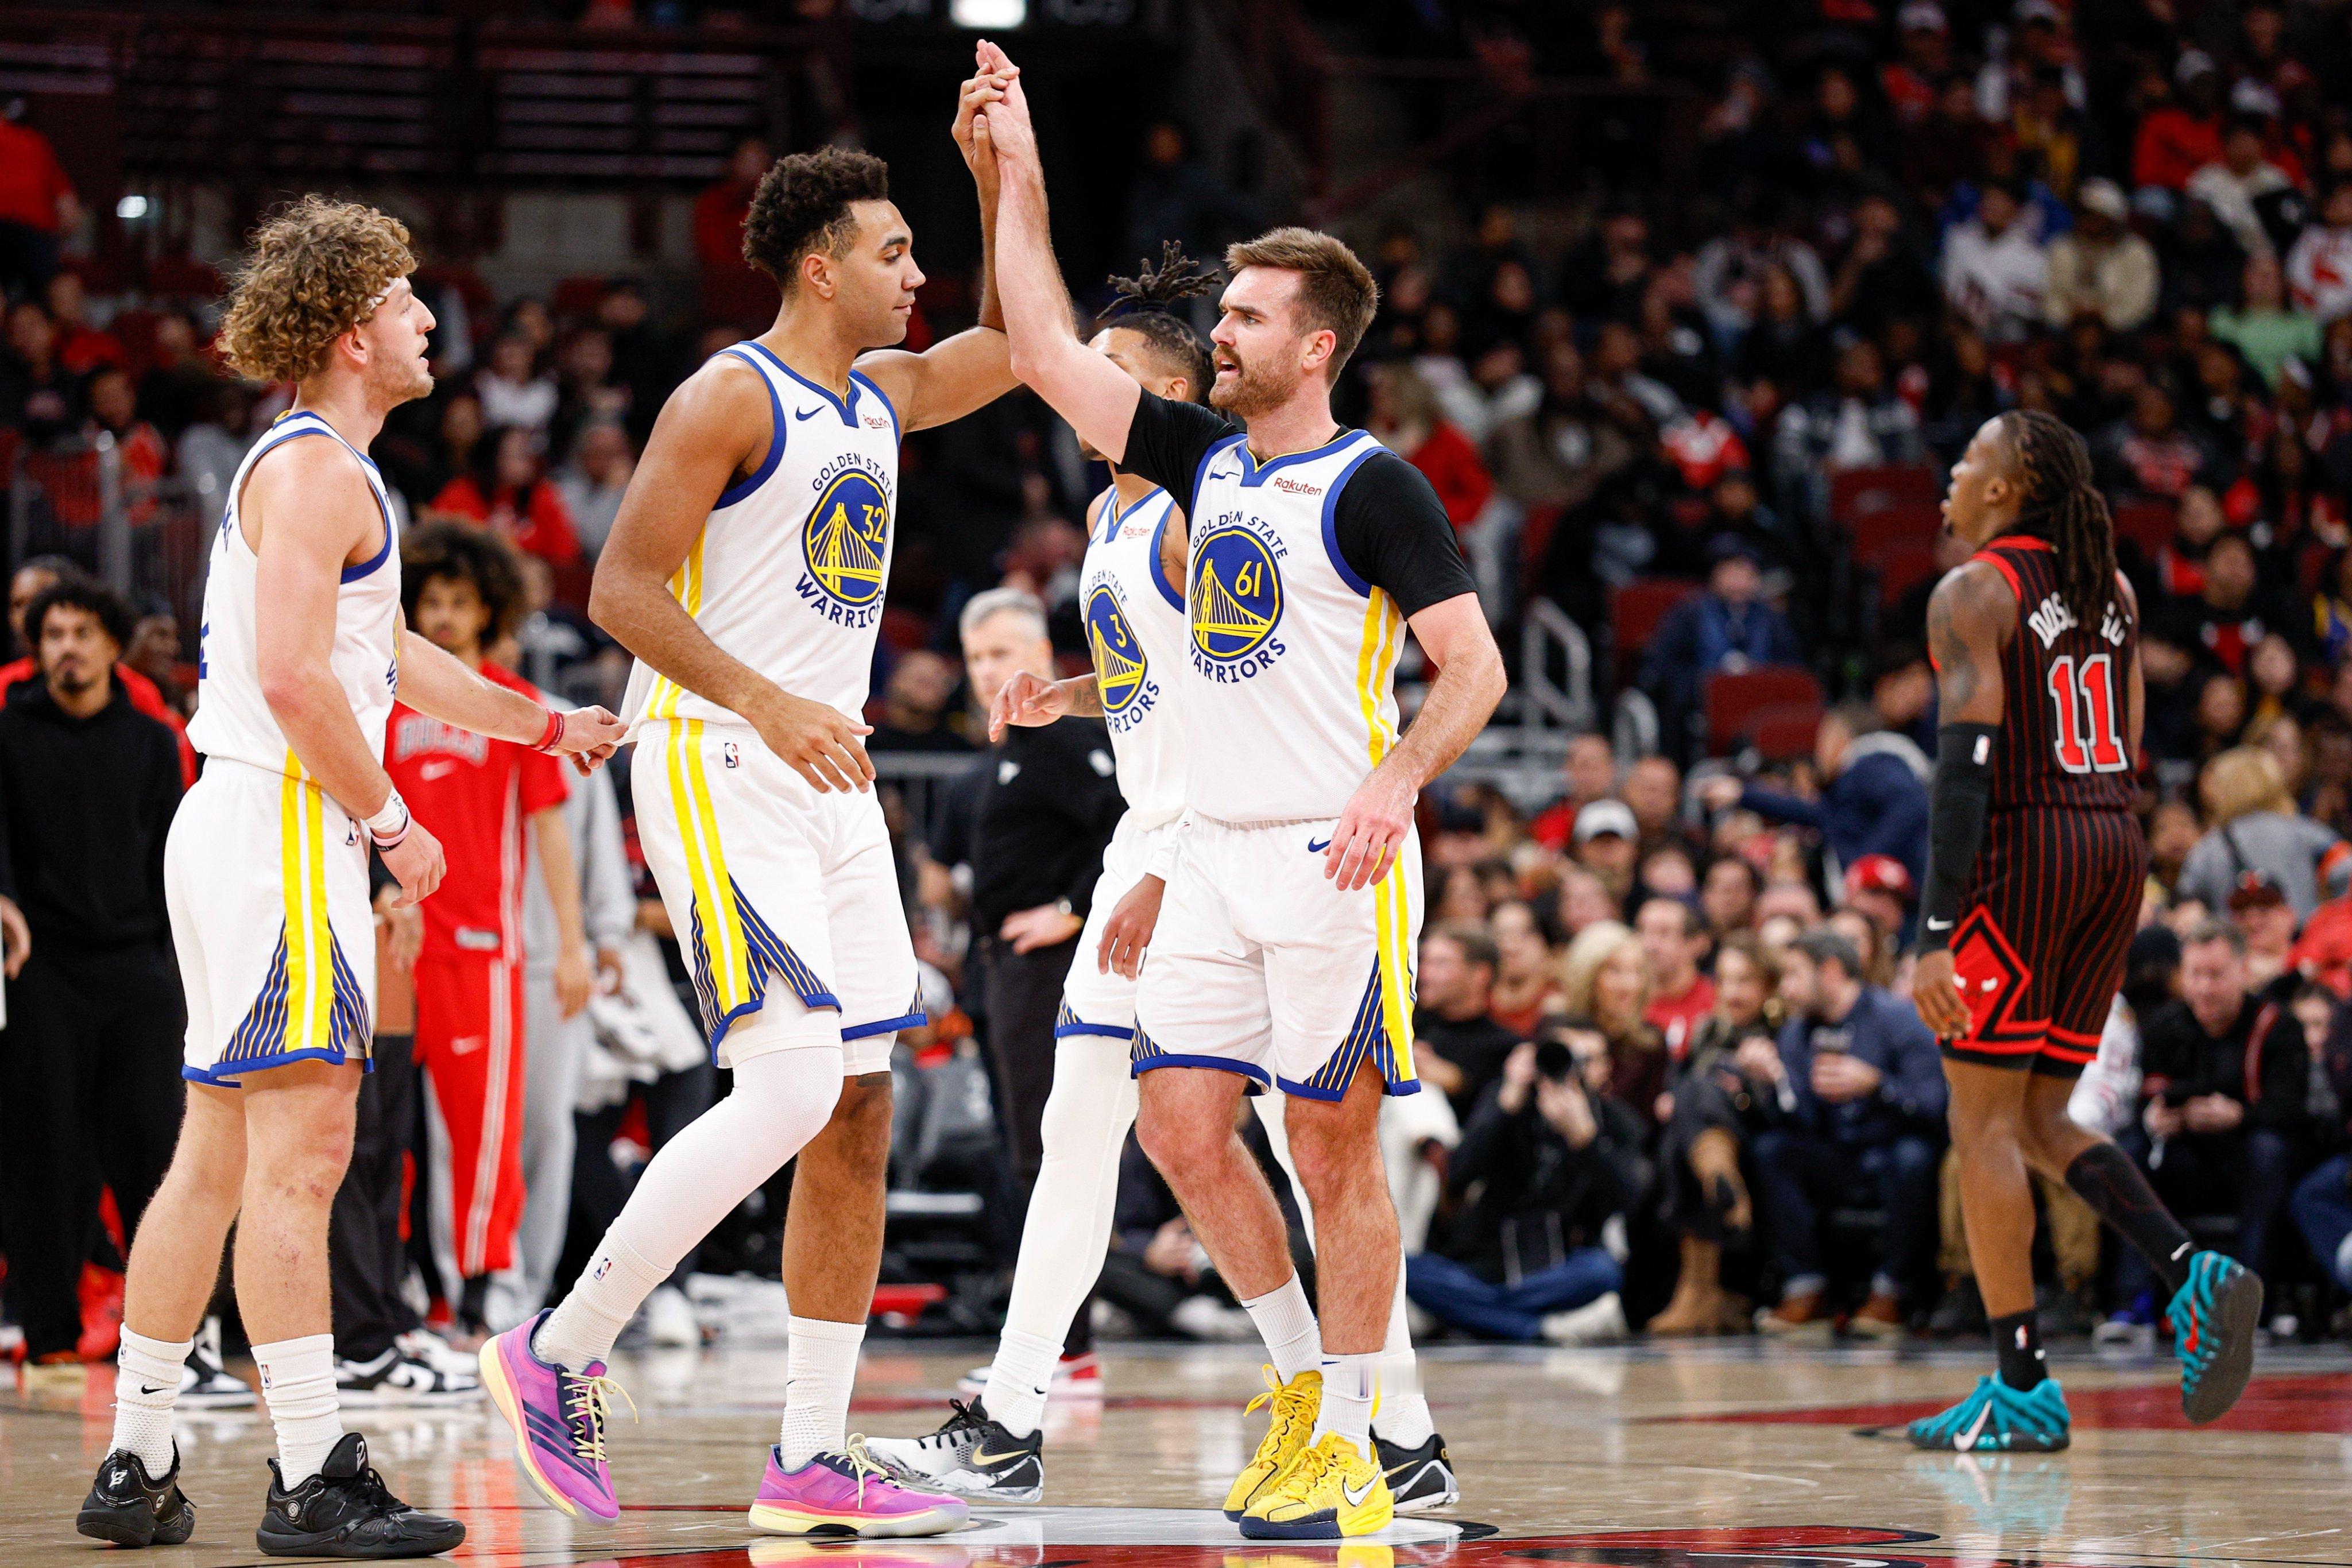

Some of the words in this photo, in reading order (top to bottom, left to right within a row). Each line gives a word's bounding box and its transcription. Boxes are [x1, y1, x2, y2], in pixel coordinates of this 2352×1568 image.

[862, 414, 891, 428] Rakutn
[813, 452, 861, 491] GOLDEN
[866, 458, 893, 501] STATE
[1274, 477, 1322, 495] Rakuten
[861, 504, 885, 544] 32
[1247, 516, 1288, 559] STATE
[1107, 571, 1128, 606] STATE
[1235, 560, 1263, 598] 61
[1109, 613, 1128, 648] 3
[1107, 680, 1159, 734] RRIORS
[2047, 653, 2129, 774] 11
